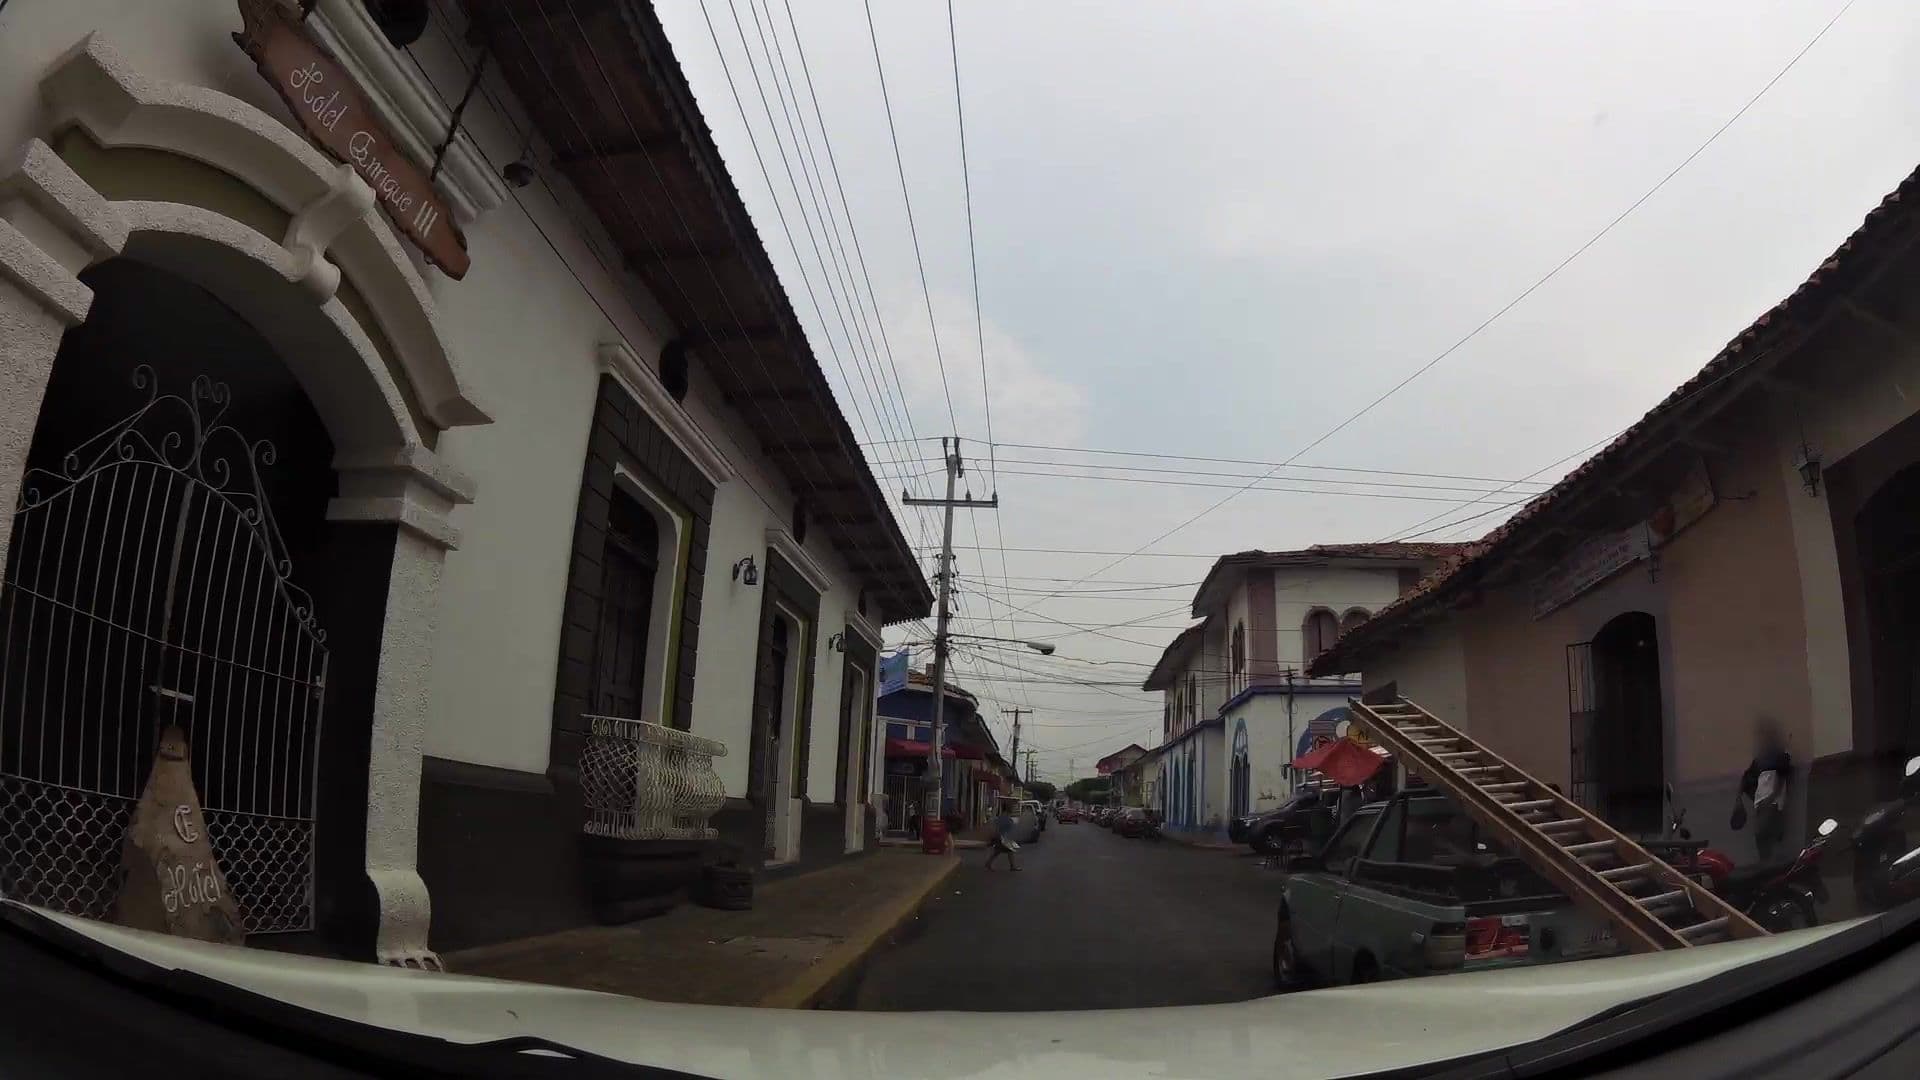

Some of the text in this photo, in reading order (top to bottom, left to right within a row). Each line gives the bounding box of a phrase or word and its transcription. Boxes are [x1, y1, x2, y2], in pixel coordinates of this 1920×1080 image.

[290, 62, 438, 238] Hotel Enrique III
